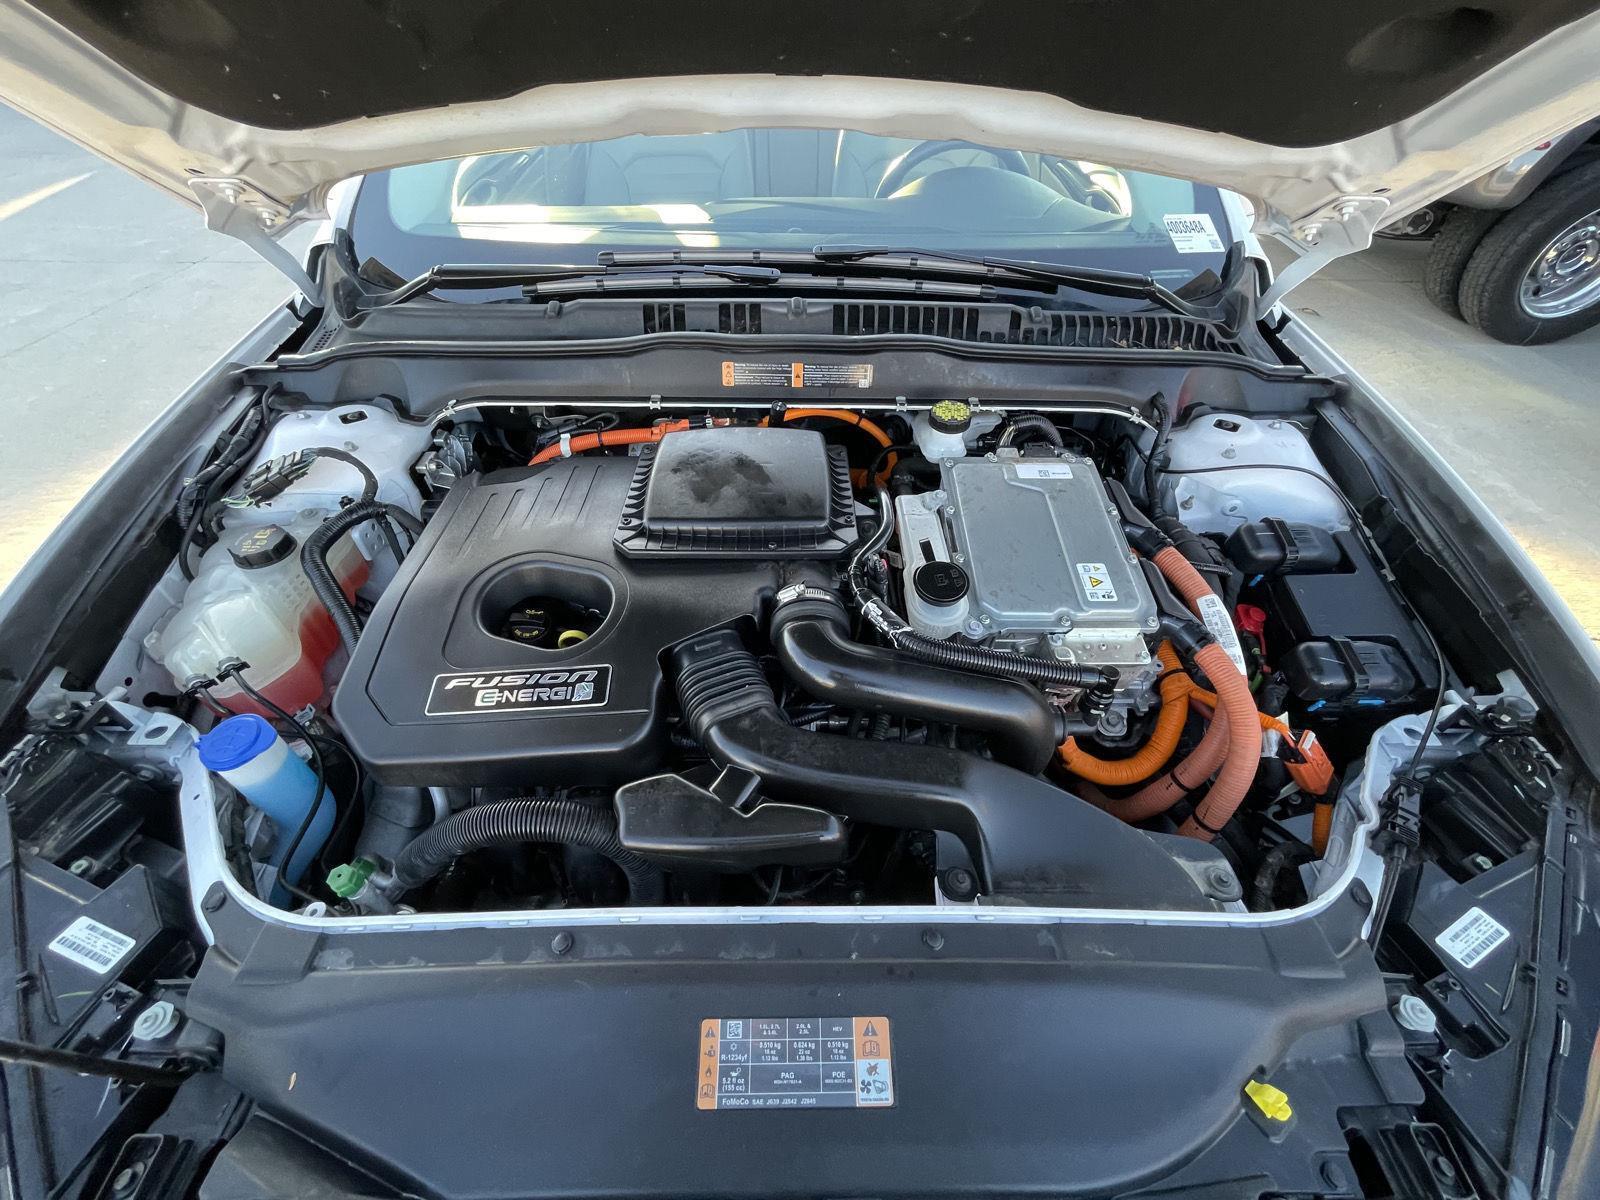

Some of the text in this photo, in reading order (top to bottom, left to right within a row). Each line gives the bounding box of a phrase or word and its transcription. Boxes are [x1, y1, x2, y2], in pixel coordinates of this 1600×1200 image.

[444, 670, 598, 690] FUSION
[721, 1054, 748, 1063] R-1234yf
[722, 1097, 749, 1106] FoMoCo
